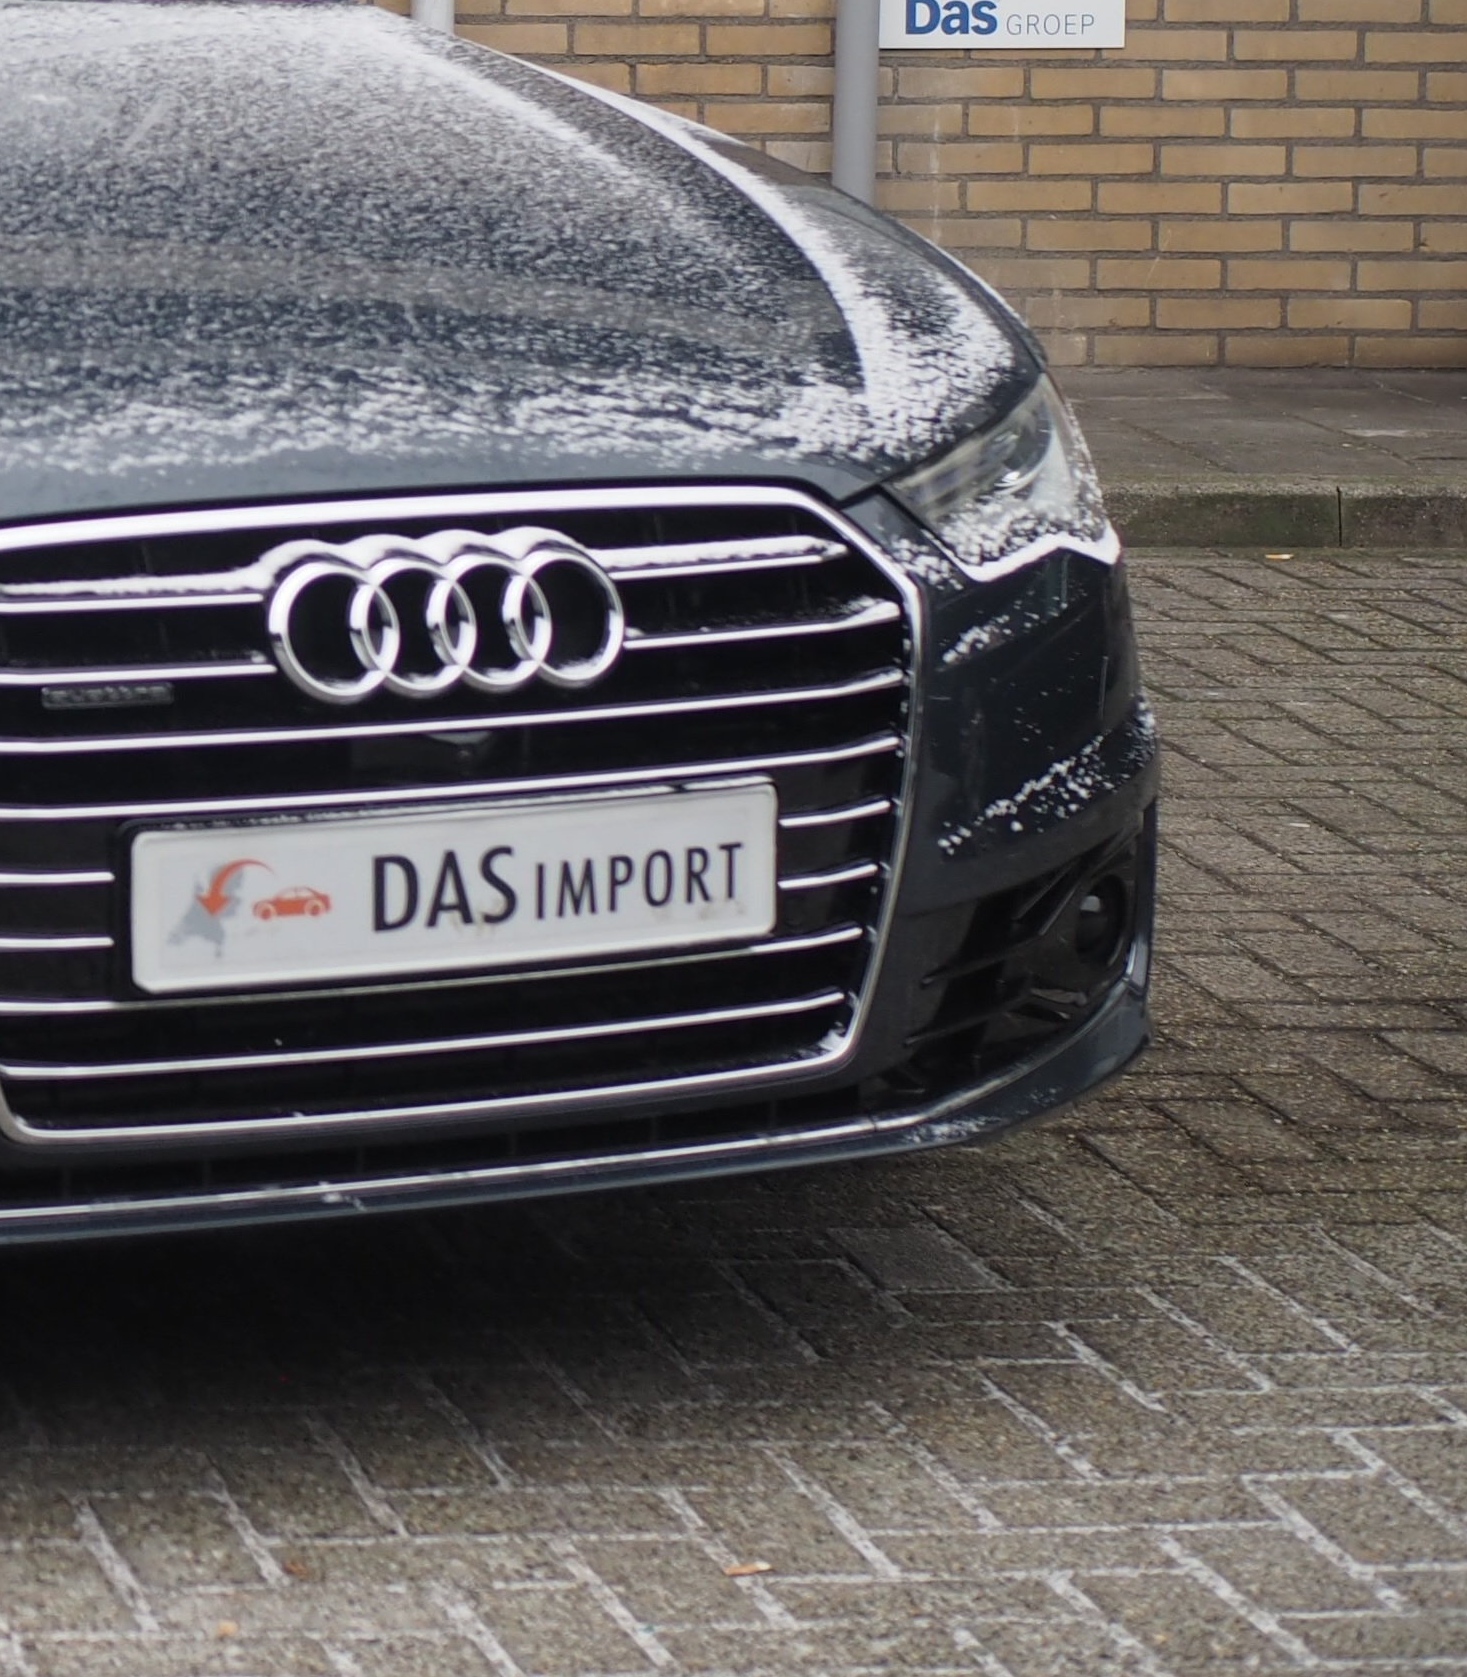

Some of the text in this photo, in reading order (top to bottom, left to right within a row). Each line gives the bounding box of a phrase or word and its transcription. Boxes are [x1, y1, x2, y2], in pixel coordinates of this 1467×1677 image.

[1006, 13, 1095, 36] GROEP
[371, 841, 745, 933] DAS IMPORT
